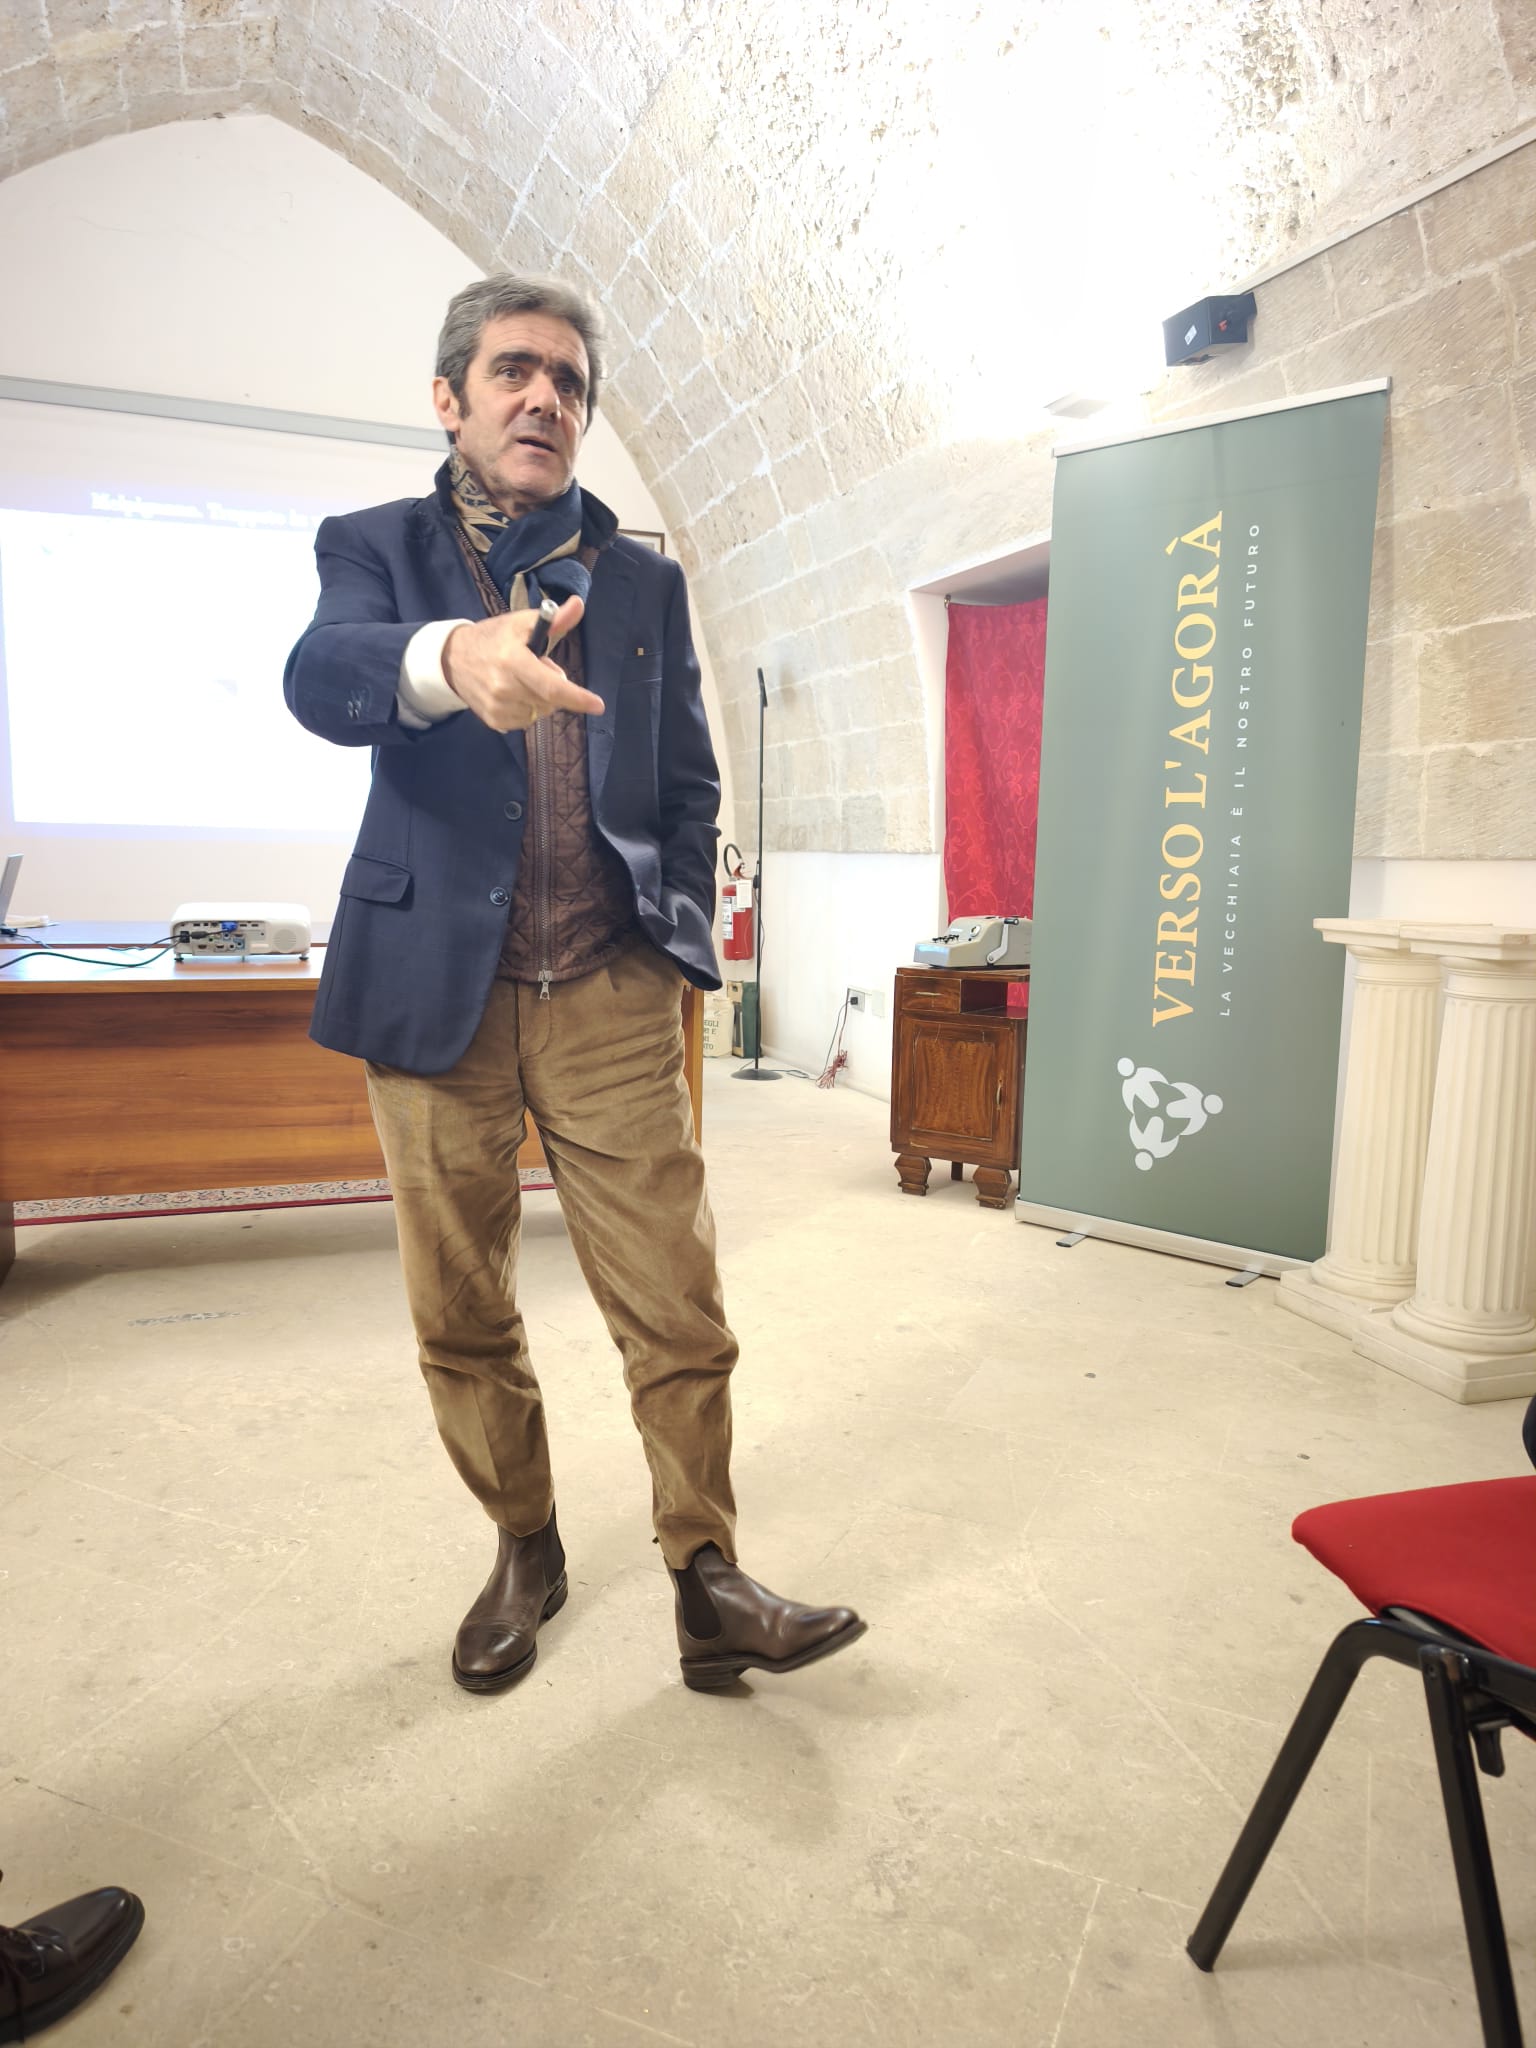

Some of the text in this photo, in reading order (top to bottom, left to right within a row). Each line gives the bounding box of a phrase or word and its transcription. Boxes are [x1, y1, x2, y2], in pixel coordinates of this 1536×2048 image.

[1152, 510, 1223, 1028] VERSO L'AGORÀ
[1219, 524, 1260, 1017] LA VECCHIAIA È IL NOSTRO FUTURO
